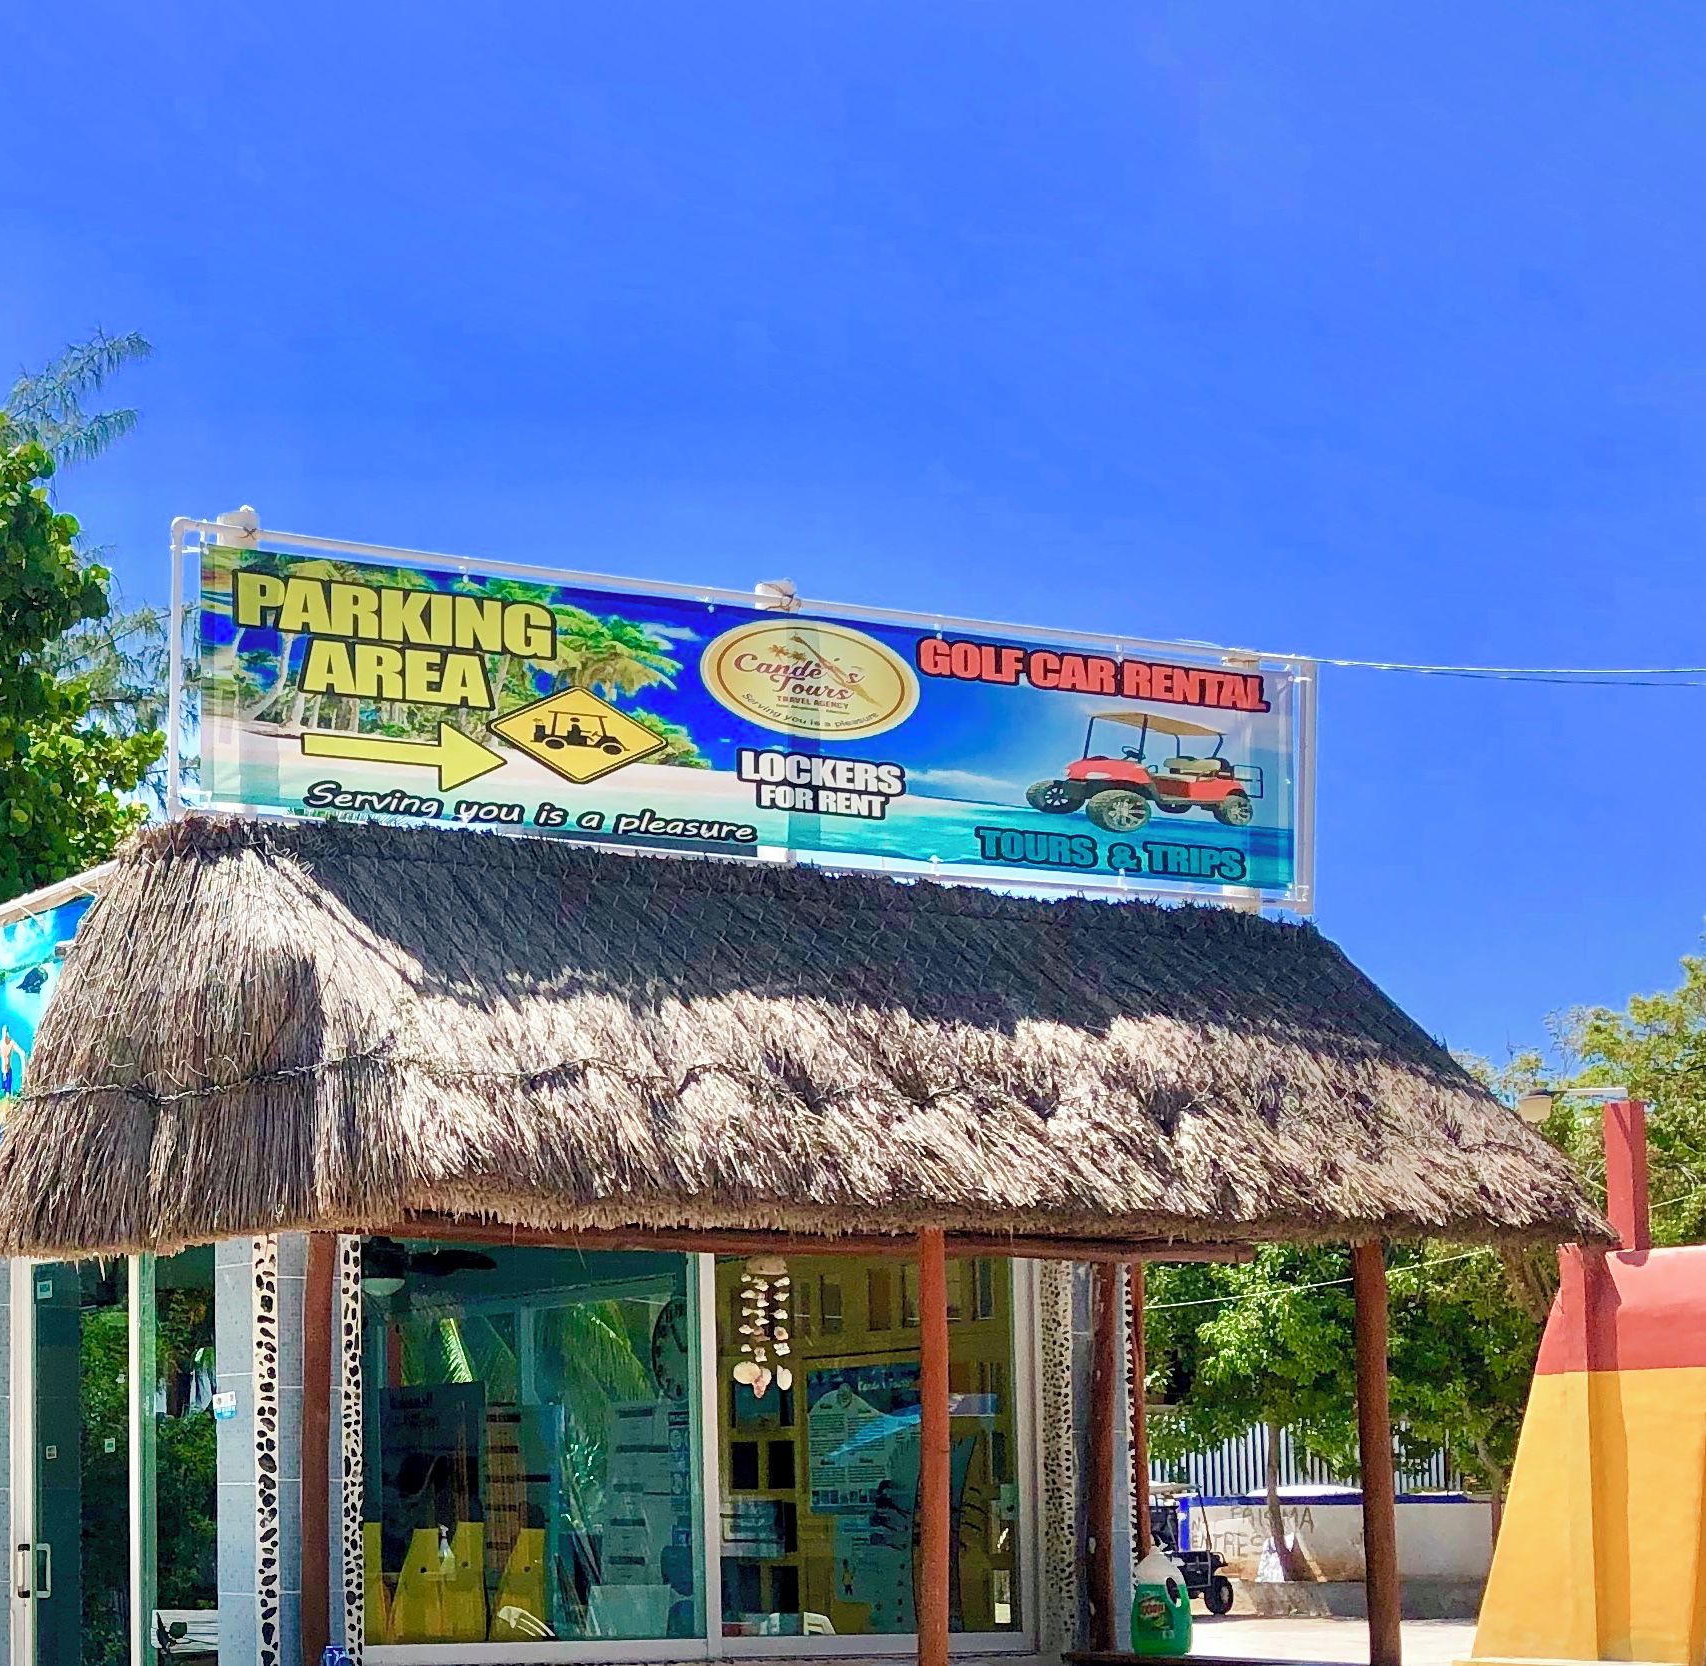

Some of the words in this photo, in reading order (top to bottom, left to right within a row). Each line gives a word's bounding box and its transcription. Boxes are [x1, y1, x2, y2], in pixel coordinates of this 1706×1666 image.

[235, 571, 555, 659] PARKING
[302, 640, 493, 709] AREA
[770, 674, 854, 700] Tours
[920, 638, 1024, 684] GOLF
[1029, 651, 1119, 694] CAR
[1121, 662, 1269, 712] RENTAL
[777, 695, 811, 705] TRAVEL
[814, 699, 849, 710] AGENCY
[783, 714, 807, 725] you
[741, 750, 904, 796] LOCKERS
[307, 783, 440, 819] Serving
[459, 803, 522, 827] you
[538, 803, 565, 827] is
[580, 811, 602, 830] a
[617, 812, 755, 842] pleasure
[760, 783, 814, 814] FOR
[817, 788, 888, 819] RENT
[978, 829, 1096, 867] TOURS
[1108, 843, 1141, 871] &
[1147, 843, 1248, 880] TRIPS
